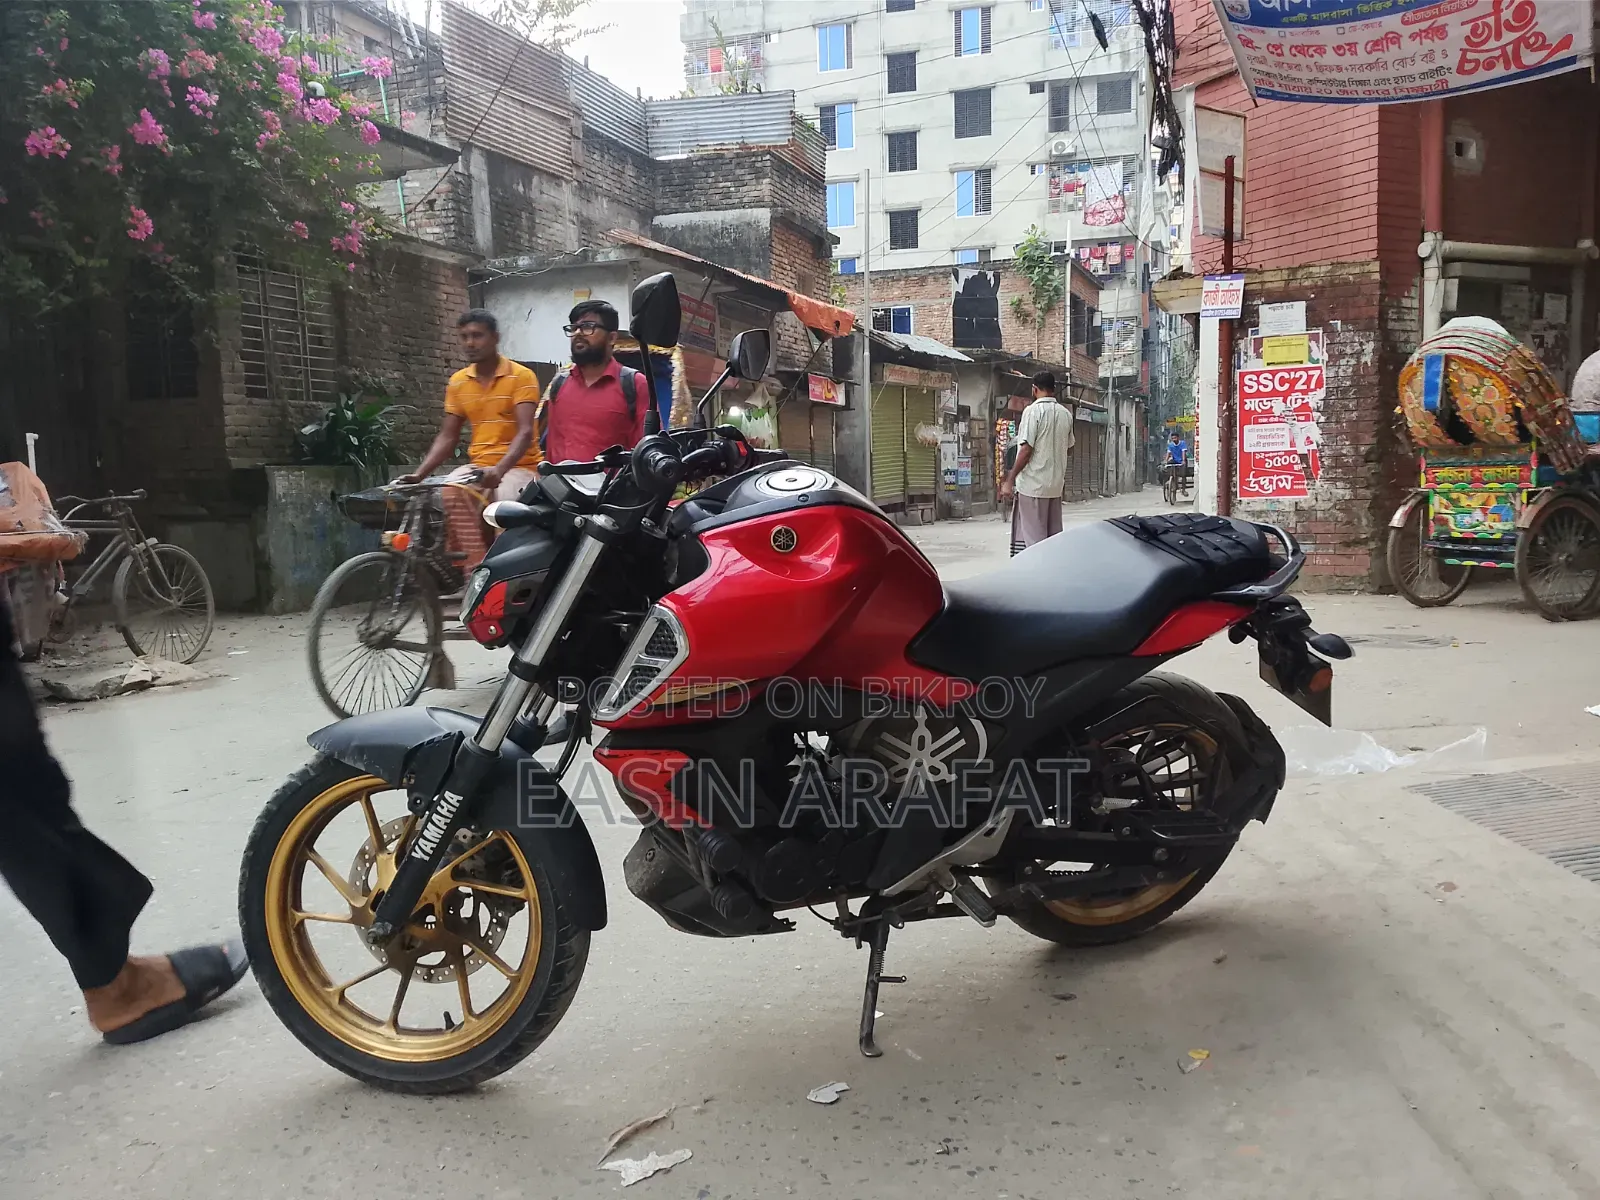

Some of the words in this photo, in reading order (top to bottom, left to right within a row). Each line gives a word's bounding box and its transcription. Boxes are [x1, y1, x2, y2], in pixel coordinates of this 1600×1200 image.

[1404, 8, 1439, 22] শীতাতপ
[1461, 0, 1537, 48] ভর্তি
[1290, 43, 1328, 58] থেকে
[1332, 42, 1359, 57] ৩য়
[1408, 19, 1449, 46] পর্যন্ত
[1456, 21, 1574, 76] চলছে
[1420, 49, 1436, 64] বই
[1440, 48, 1449, 60] ও
[1316, 87, 1333, 95] ২০
[1362, 87, 1391, 96] করে
[1373, 78, 1392, 87] এবং
[1203, 283, 1219, 306] কাজী
[1220, 283, 1240, 305] অফিস
[1243, 369, 1321, 394] SSC'27
[1242, 471, 1295, 494] উদ্ভাস
[411, 790, 464, 862] YAMAHA
